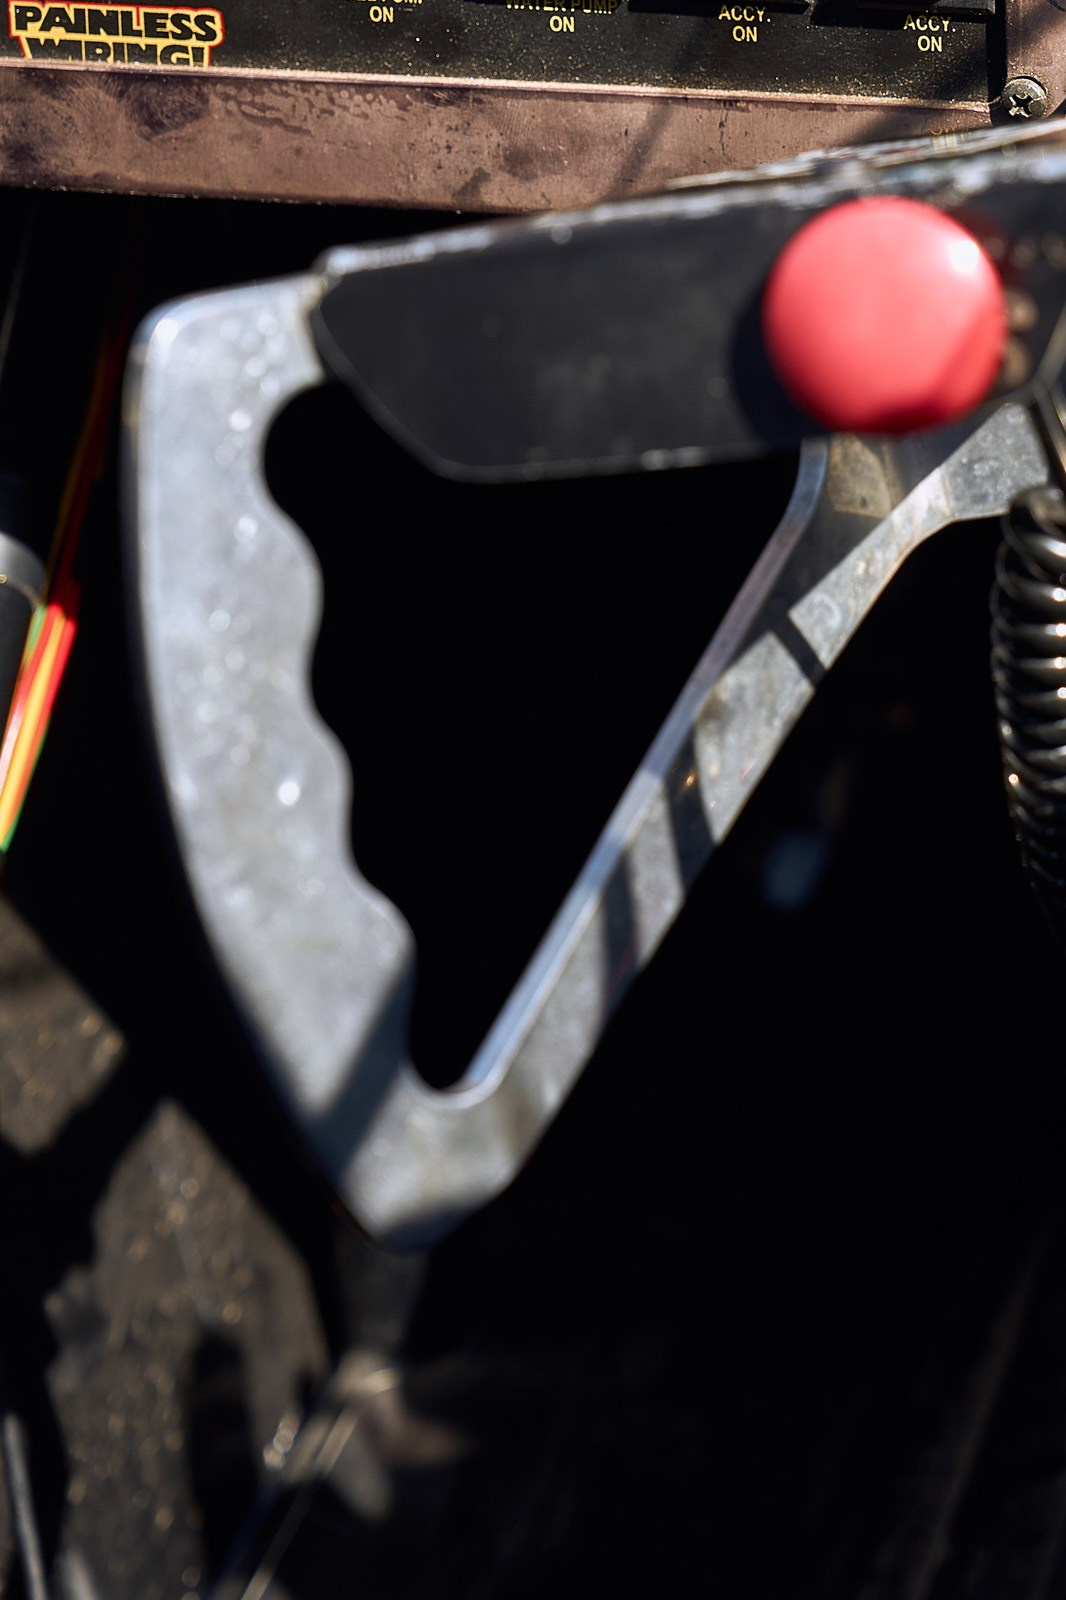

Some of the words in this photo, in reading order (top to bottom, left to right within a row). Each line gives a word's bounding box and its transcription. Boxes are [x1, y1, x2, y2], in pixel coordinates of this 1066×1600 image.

[369, 5, 394, 23] ON
[719, 5, 771, 22] ACCY.
[14, 5, 218, 42] PAINLESS
[549, 15, 575, 33] ON
[903, 15, 956, 32] ACCY.
[732, 25, 758, 43] ON
[917, 35, 943, 53] ON
